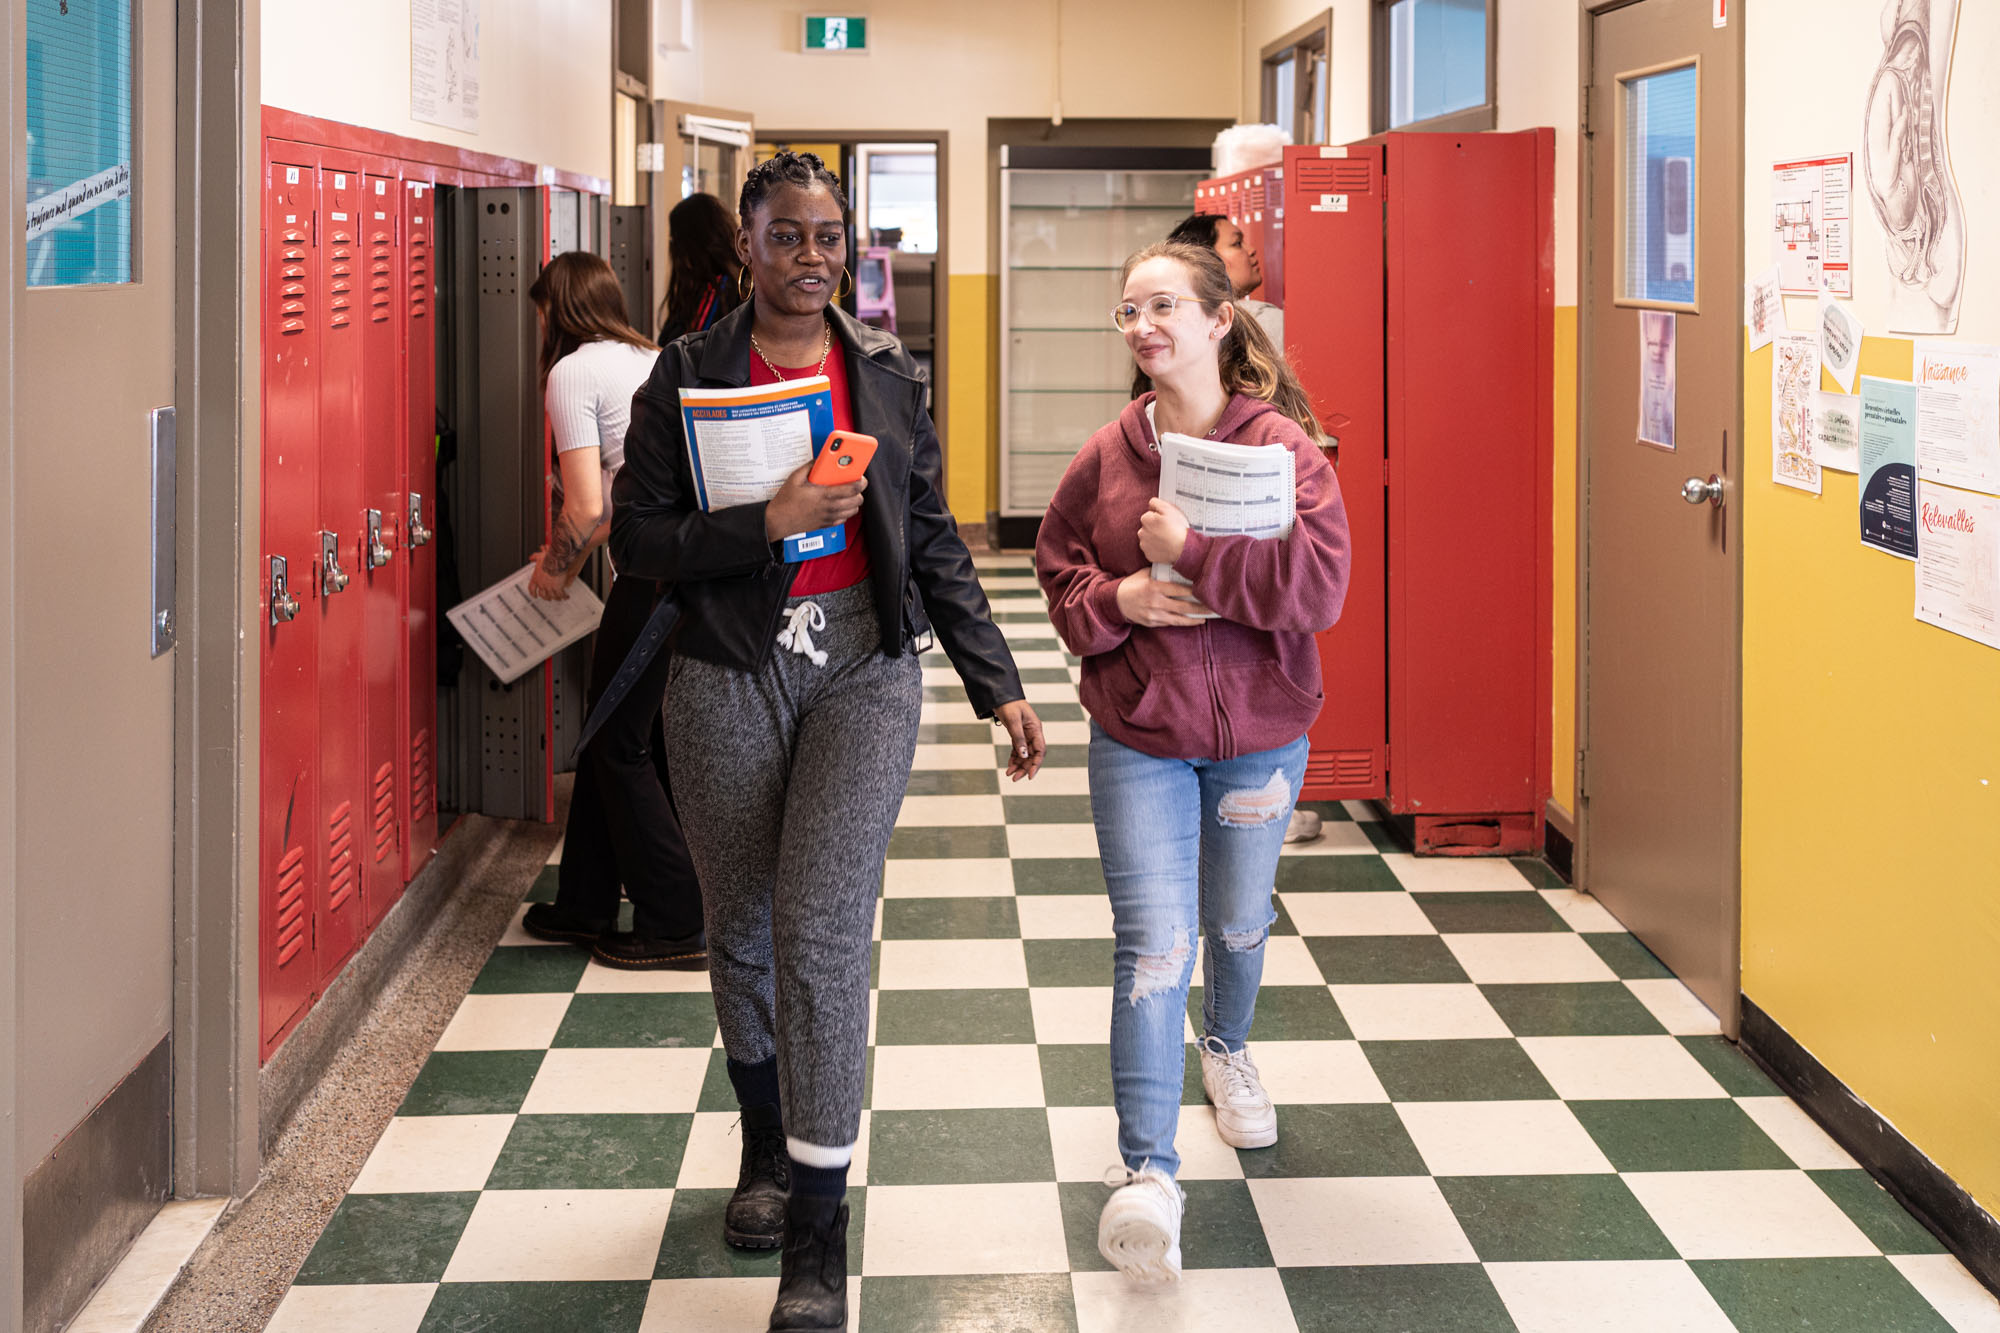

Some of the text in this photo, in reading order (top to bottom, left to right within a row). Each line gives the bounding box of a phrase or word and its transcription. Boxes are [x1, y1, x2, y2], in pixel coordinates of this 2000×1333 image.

[31, 206, 55, 231] toujours
[55, 192, 68, 216] mal
[68, 183, 87, 217] quand
[86, 189, 94, 200] on
[103, 176, 114, 191] rien
[1916, 355, 1968, 385] Naissance
[1922, 502, 1976, 534] Relevailles
